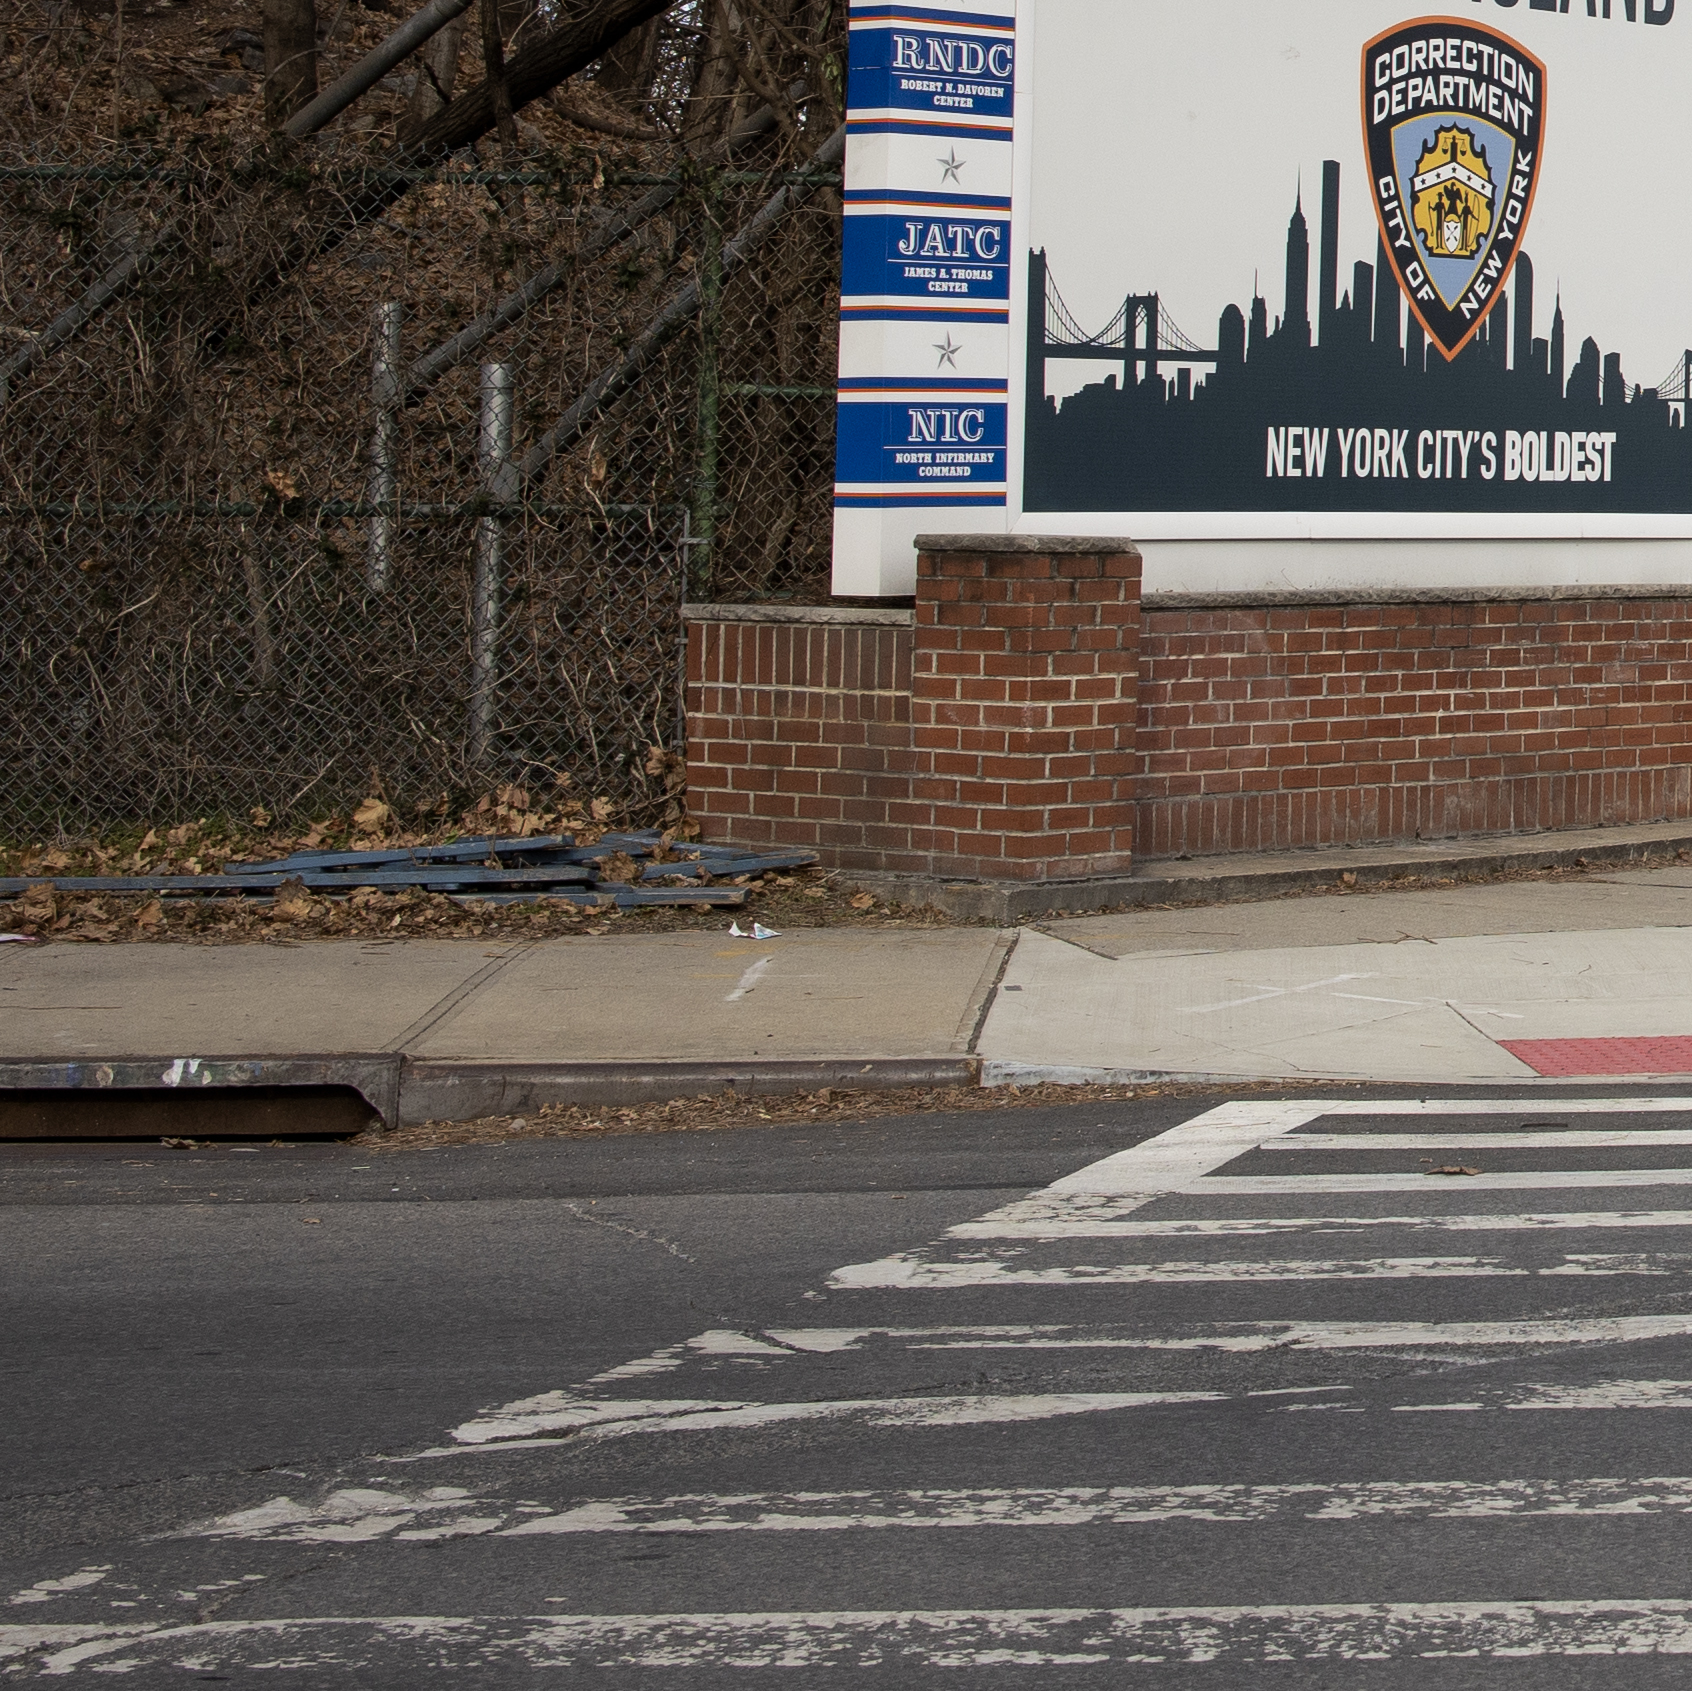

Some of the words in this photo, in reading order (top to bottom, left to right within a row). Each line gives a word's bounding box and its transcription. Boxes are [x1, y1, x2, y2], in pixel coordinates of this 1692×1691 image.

[892, 34, 1013, 77] RNDC
[1374, 38, 1534, 103] CORRECTION
[900, 78, 943, 92] ROBERT
[945, 82, 956, 93] N.
[957, 83, 1005, 98] DAVOREN
[933, 94, 973, 108] CENTER
[1373, 75, 1533, 136] DEPARTMENT
[898, 222, 1001, 259] JATC
[1379, 175, 1411, 251] CITY
[1405, 261, 1435, 301] OF
[1460, 249, 1503, 320] NEW
[1497, 148, 1533, 241] YORK
[903, 266, 937, 278] JAMES
[939, 268, 950, 279] A.
[951, 268, 994, 280] THOMAS
[928, 281, 969, 293] CENTER
[907, 408, 985, 442] NIC
[895, 453, 933, 463] NORTH
[935, 453, 995, 463] INFIRMARY
[918, 466, 972, 477] COMMAND
[1266, 426, 1330, 478] NEW
[1337, 427, 1410, 479] YORK
[1417, 429, 1498, 480] CITY'S
[1504, 430, 1617, 482] BOLDEST
